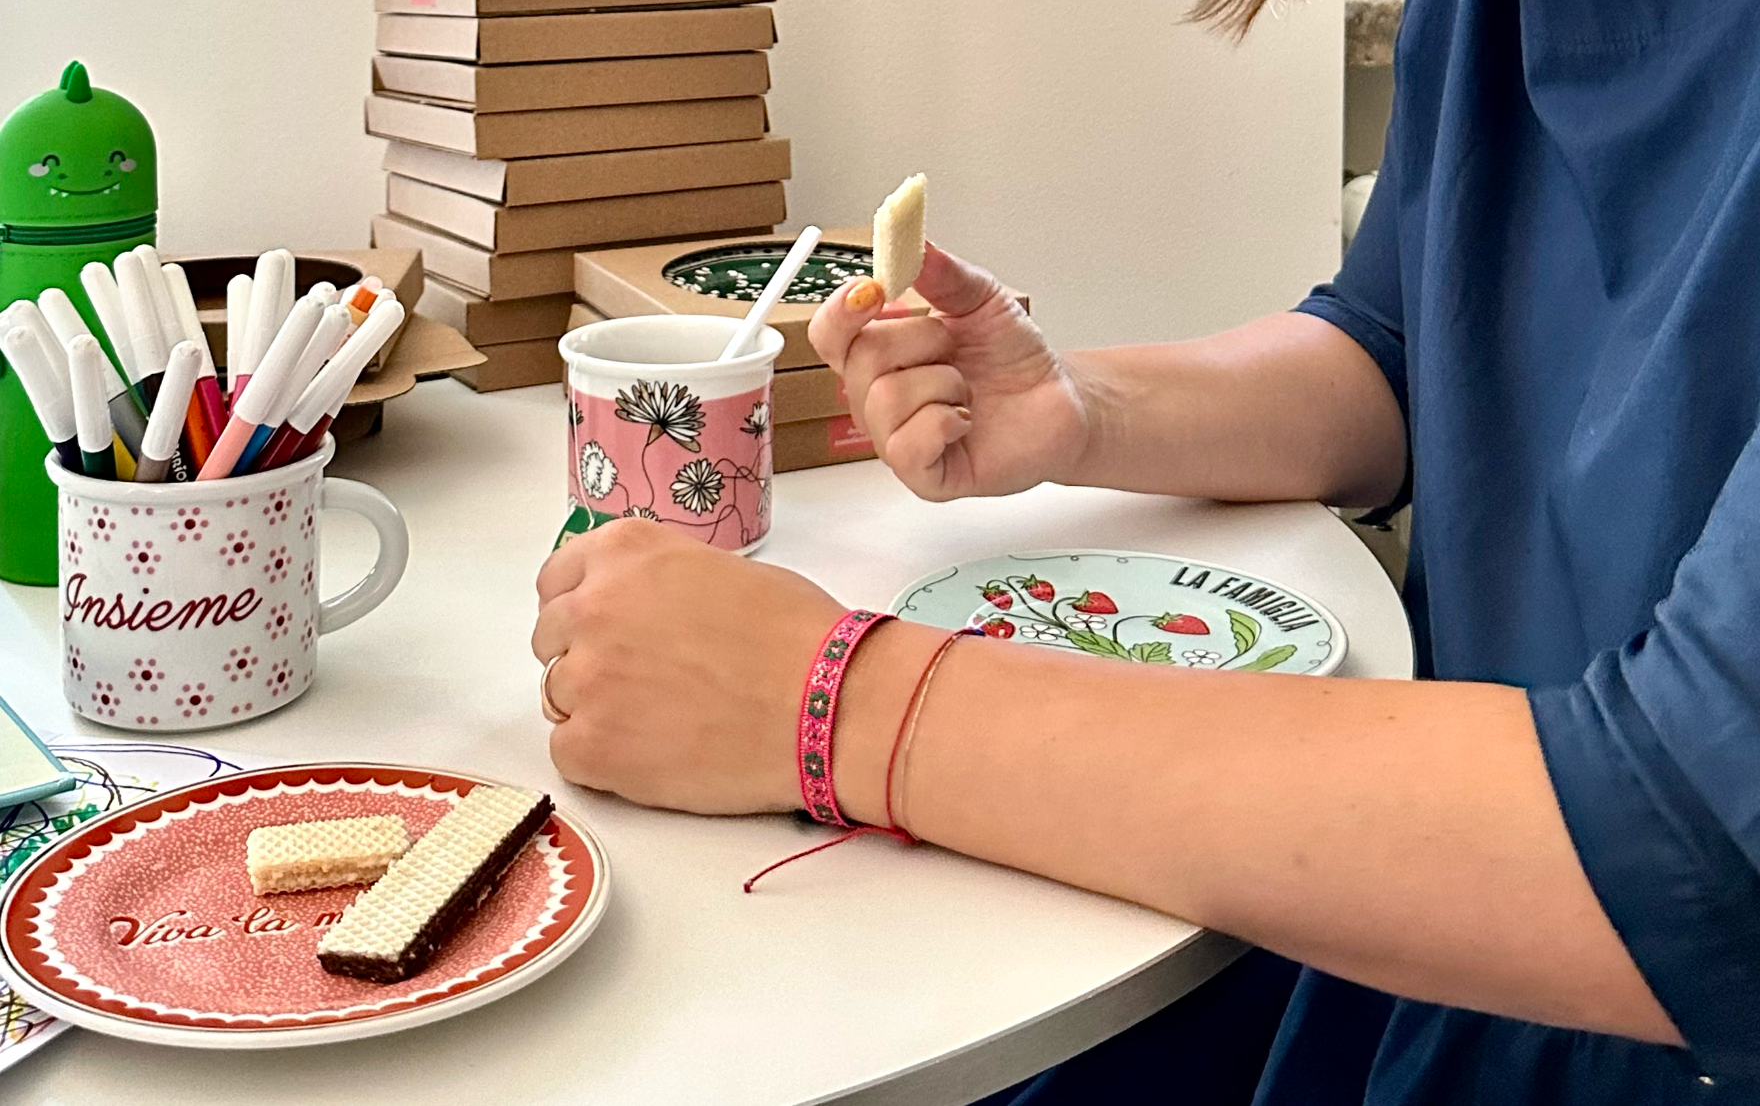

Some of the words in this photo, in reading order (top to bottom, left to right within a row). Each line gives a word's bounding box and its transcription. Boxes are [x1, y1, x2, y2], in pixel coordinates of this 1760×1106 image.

[63, 573, 263, 632] Insieme
[1169, 566, 1211, 589] LA
[1207, 576, 1320, 632] FAMIGLIA
[109, 910, 223, 946] Viva
[231, 906, 298, 935] la
